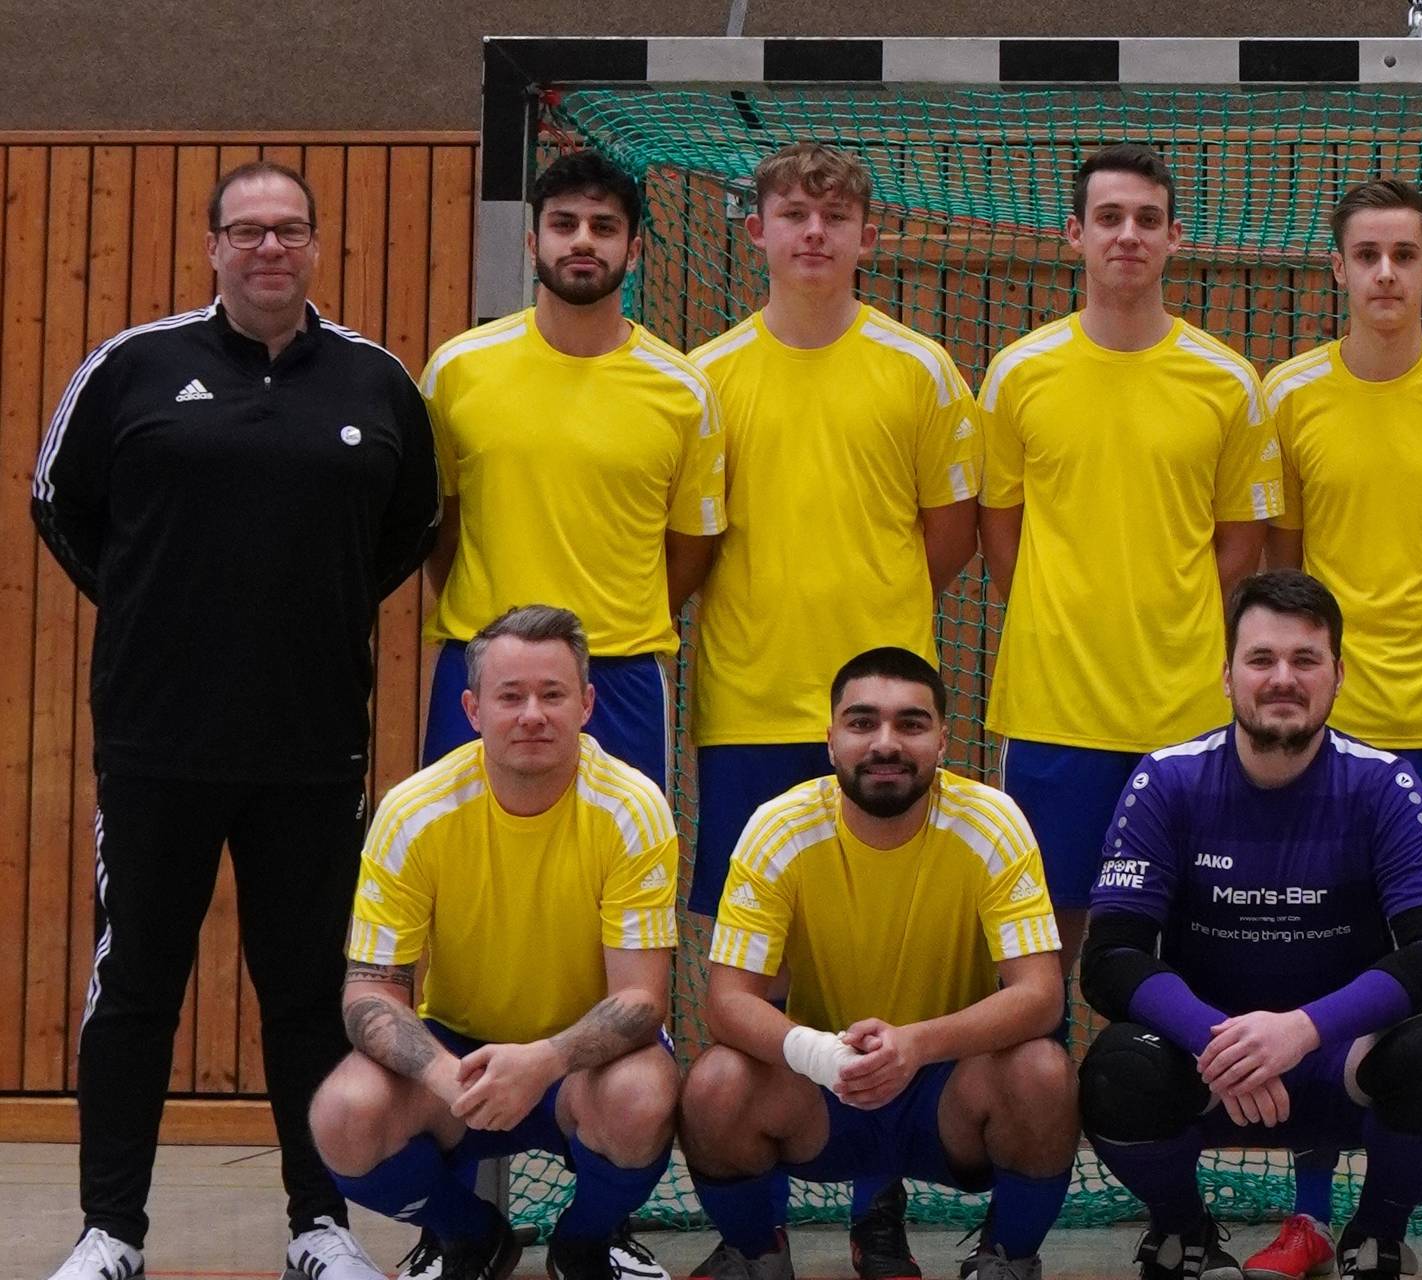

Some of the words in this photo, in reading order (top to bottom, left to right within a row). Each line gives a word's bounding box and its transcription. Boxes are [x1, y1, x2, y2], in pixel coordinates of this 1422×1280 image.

[175, 391, 214, 402] adidas
[1195, 853, 1234, 869] JAKO
[1212, 886, 1328, 905] Men's-Bar
[1191, 921, 1210, 935] the
[1211, 927, 1240, 940] next
[1241, 930, 1260, 942] big
[1261, 929, 1292, 943] thing
[1293, 929, 1305, 940] in
[1306, 925, 1352, 940] events
